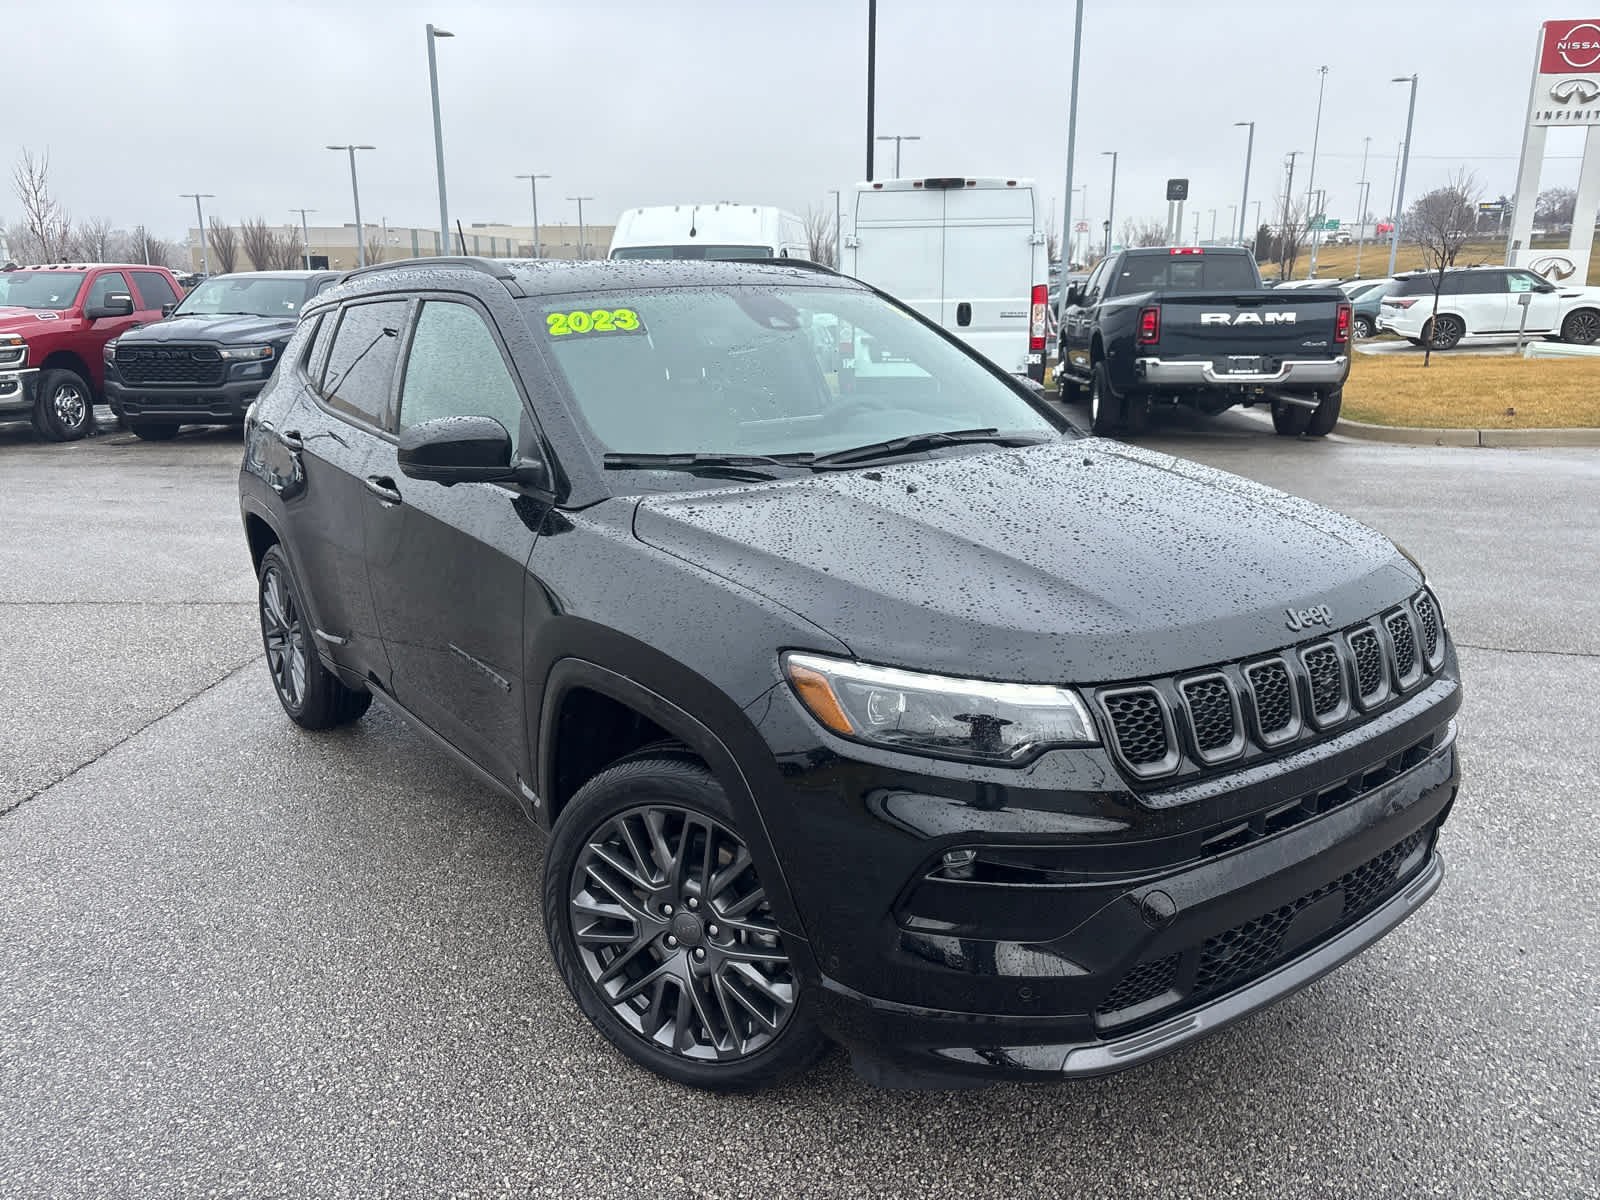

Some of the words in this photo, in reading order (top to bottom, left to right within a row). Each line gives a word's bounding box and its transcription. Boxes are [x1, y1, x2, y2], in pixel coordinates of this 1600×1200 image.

[546, 309, 640, 336] 2023
[1200, 312, 1297, 326] RAM
[1285, 604, 1332, 632] Jeep
